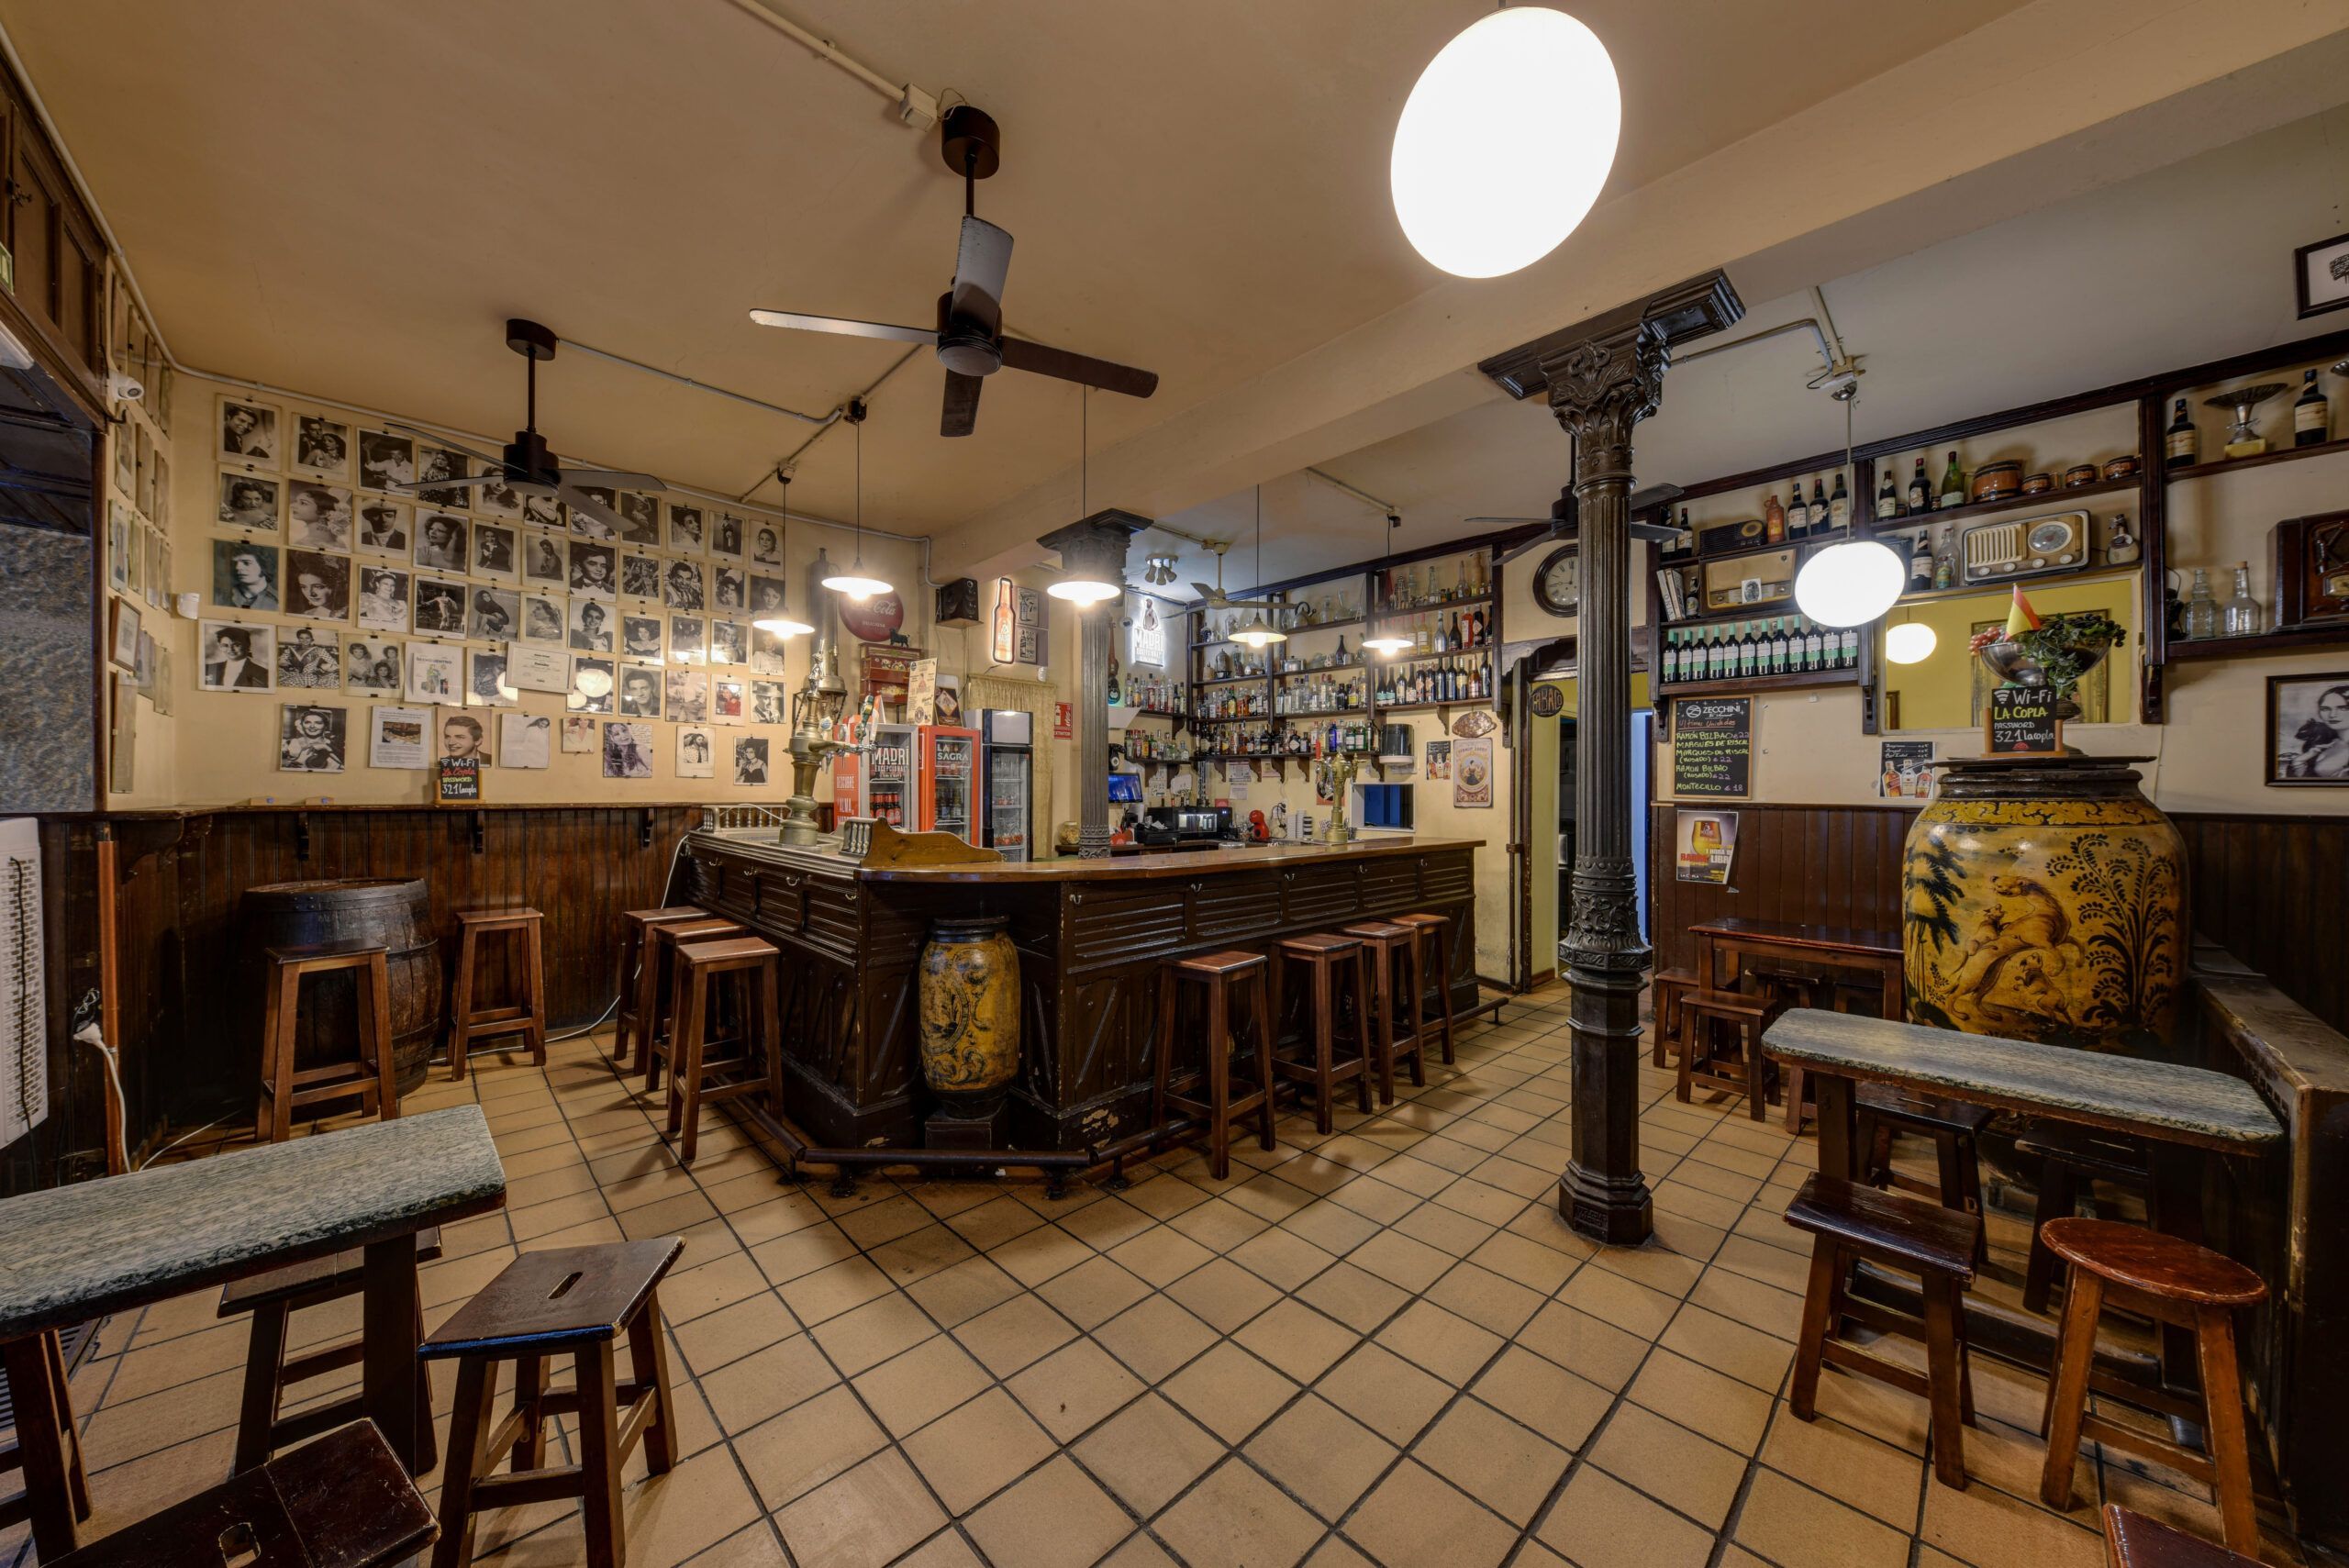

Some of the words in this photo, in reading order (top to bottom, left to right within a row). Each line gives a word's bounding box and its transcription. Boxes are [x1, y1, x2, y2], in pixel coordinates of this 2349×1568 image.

[2012, 689, 2053, 705] Wi-Fi
[1702, 705, 1741, 714] ZECCHINI
[1994, 706, 2011, 720] LA
[1994, 721, 2035, 729] PASSWORD
[1699, 731, 1732, 740] BILBAO
[936, 743, 950, 752] LA
[937, 752, 969, 761] SAGRA
[1675, 749, 1714, 757] MARQUES
[451, 758, 475, 767] Wi-Fi
[1701, 764, 1729, 773] BILBAO
[1675, 782, 1722, 791] MONTECILLO
[1710, 854, 1730, 864] LIBR
